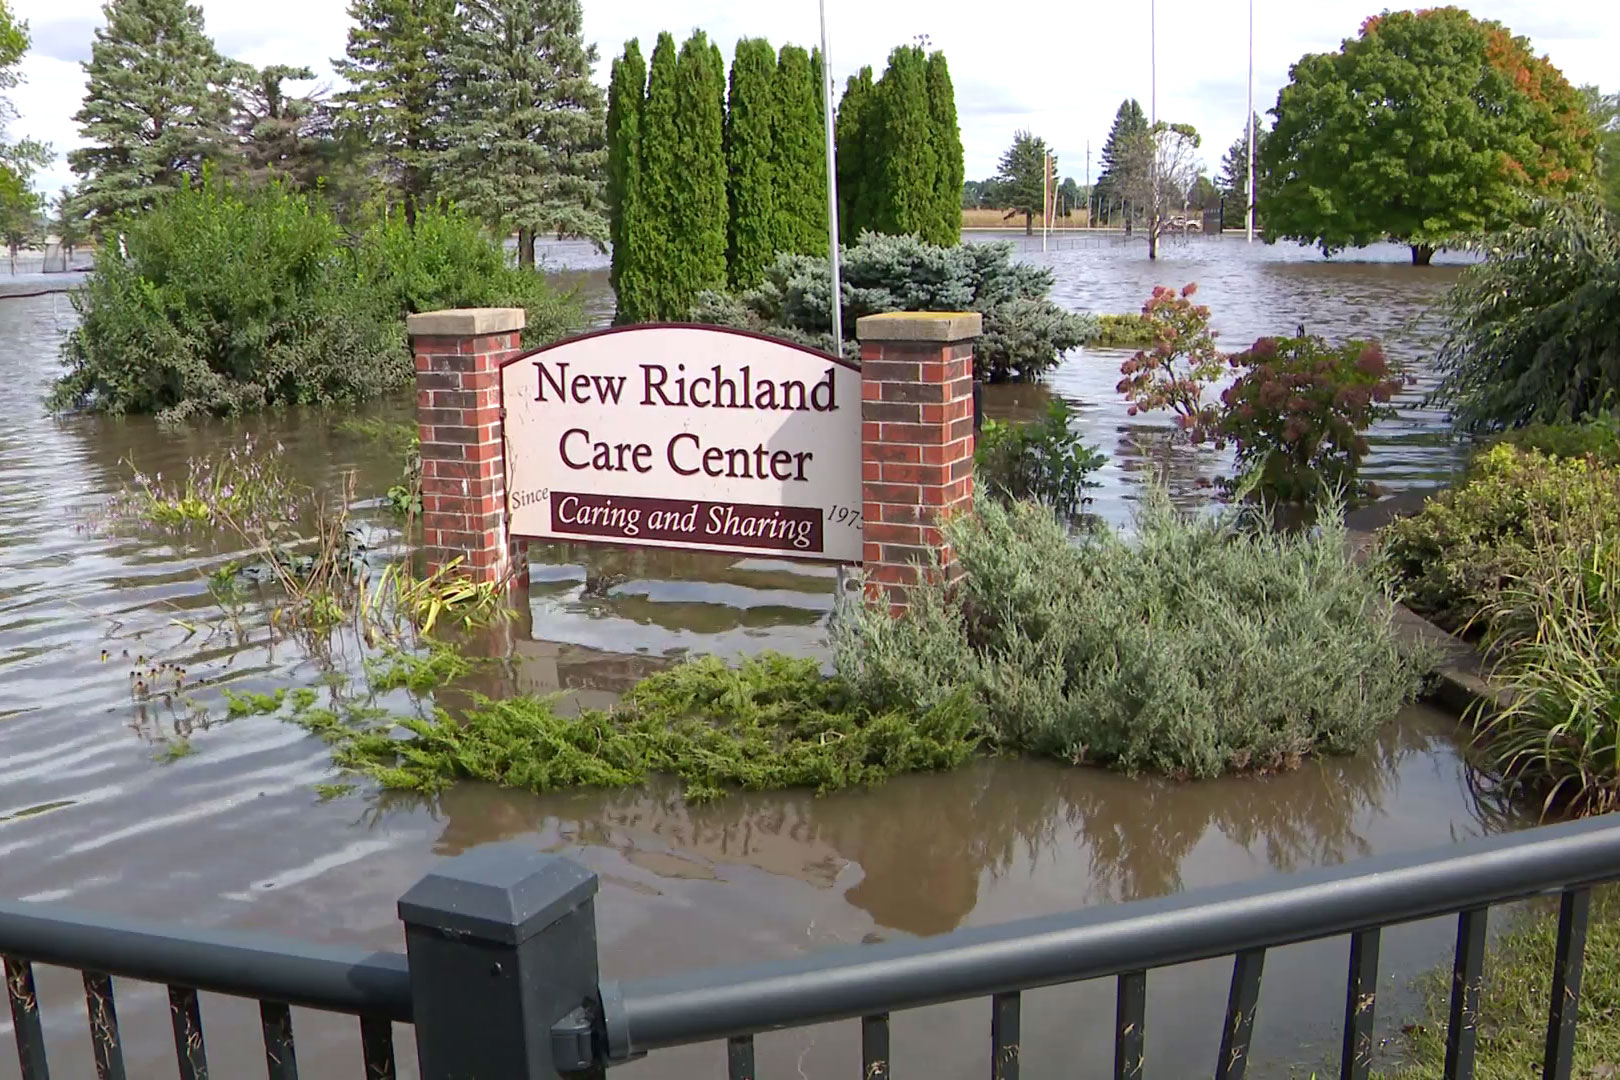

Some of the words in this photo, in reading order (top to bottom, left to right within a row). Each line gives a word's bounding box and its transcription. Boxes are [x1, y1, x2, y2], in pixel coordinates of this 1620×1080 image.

[532, 361, 627, 405] New
[639, 363, 840, 412] Richland
[559, 428, 653, 474] Care
[666, 432, 814, 482] Center
[511, 487, 549, 510] Since
[558, 496, 641, 535] Caring
[648, 503, 699, 534] and
[705, 505, 814, 548] Sharing
